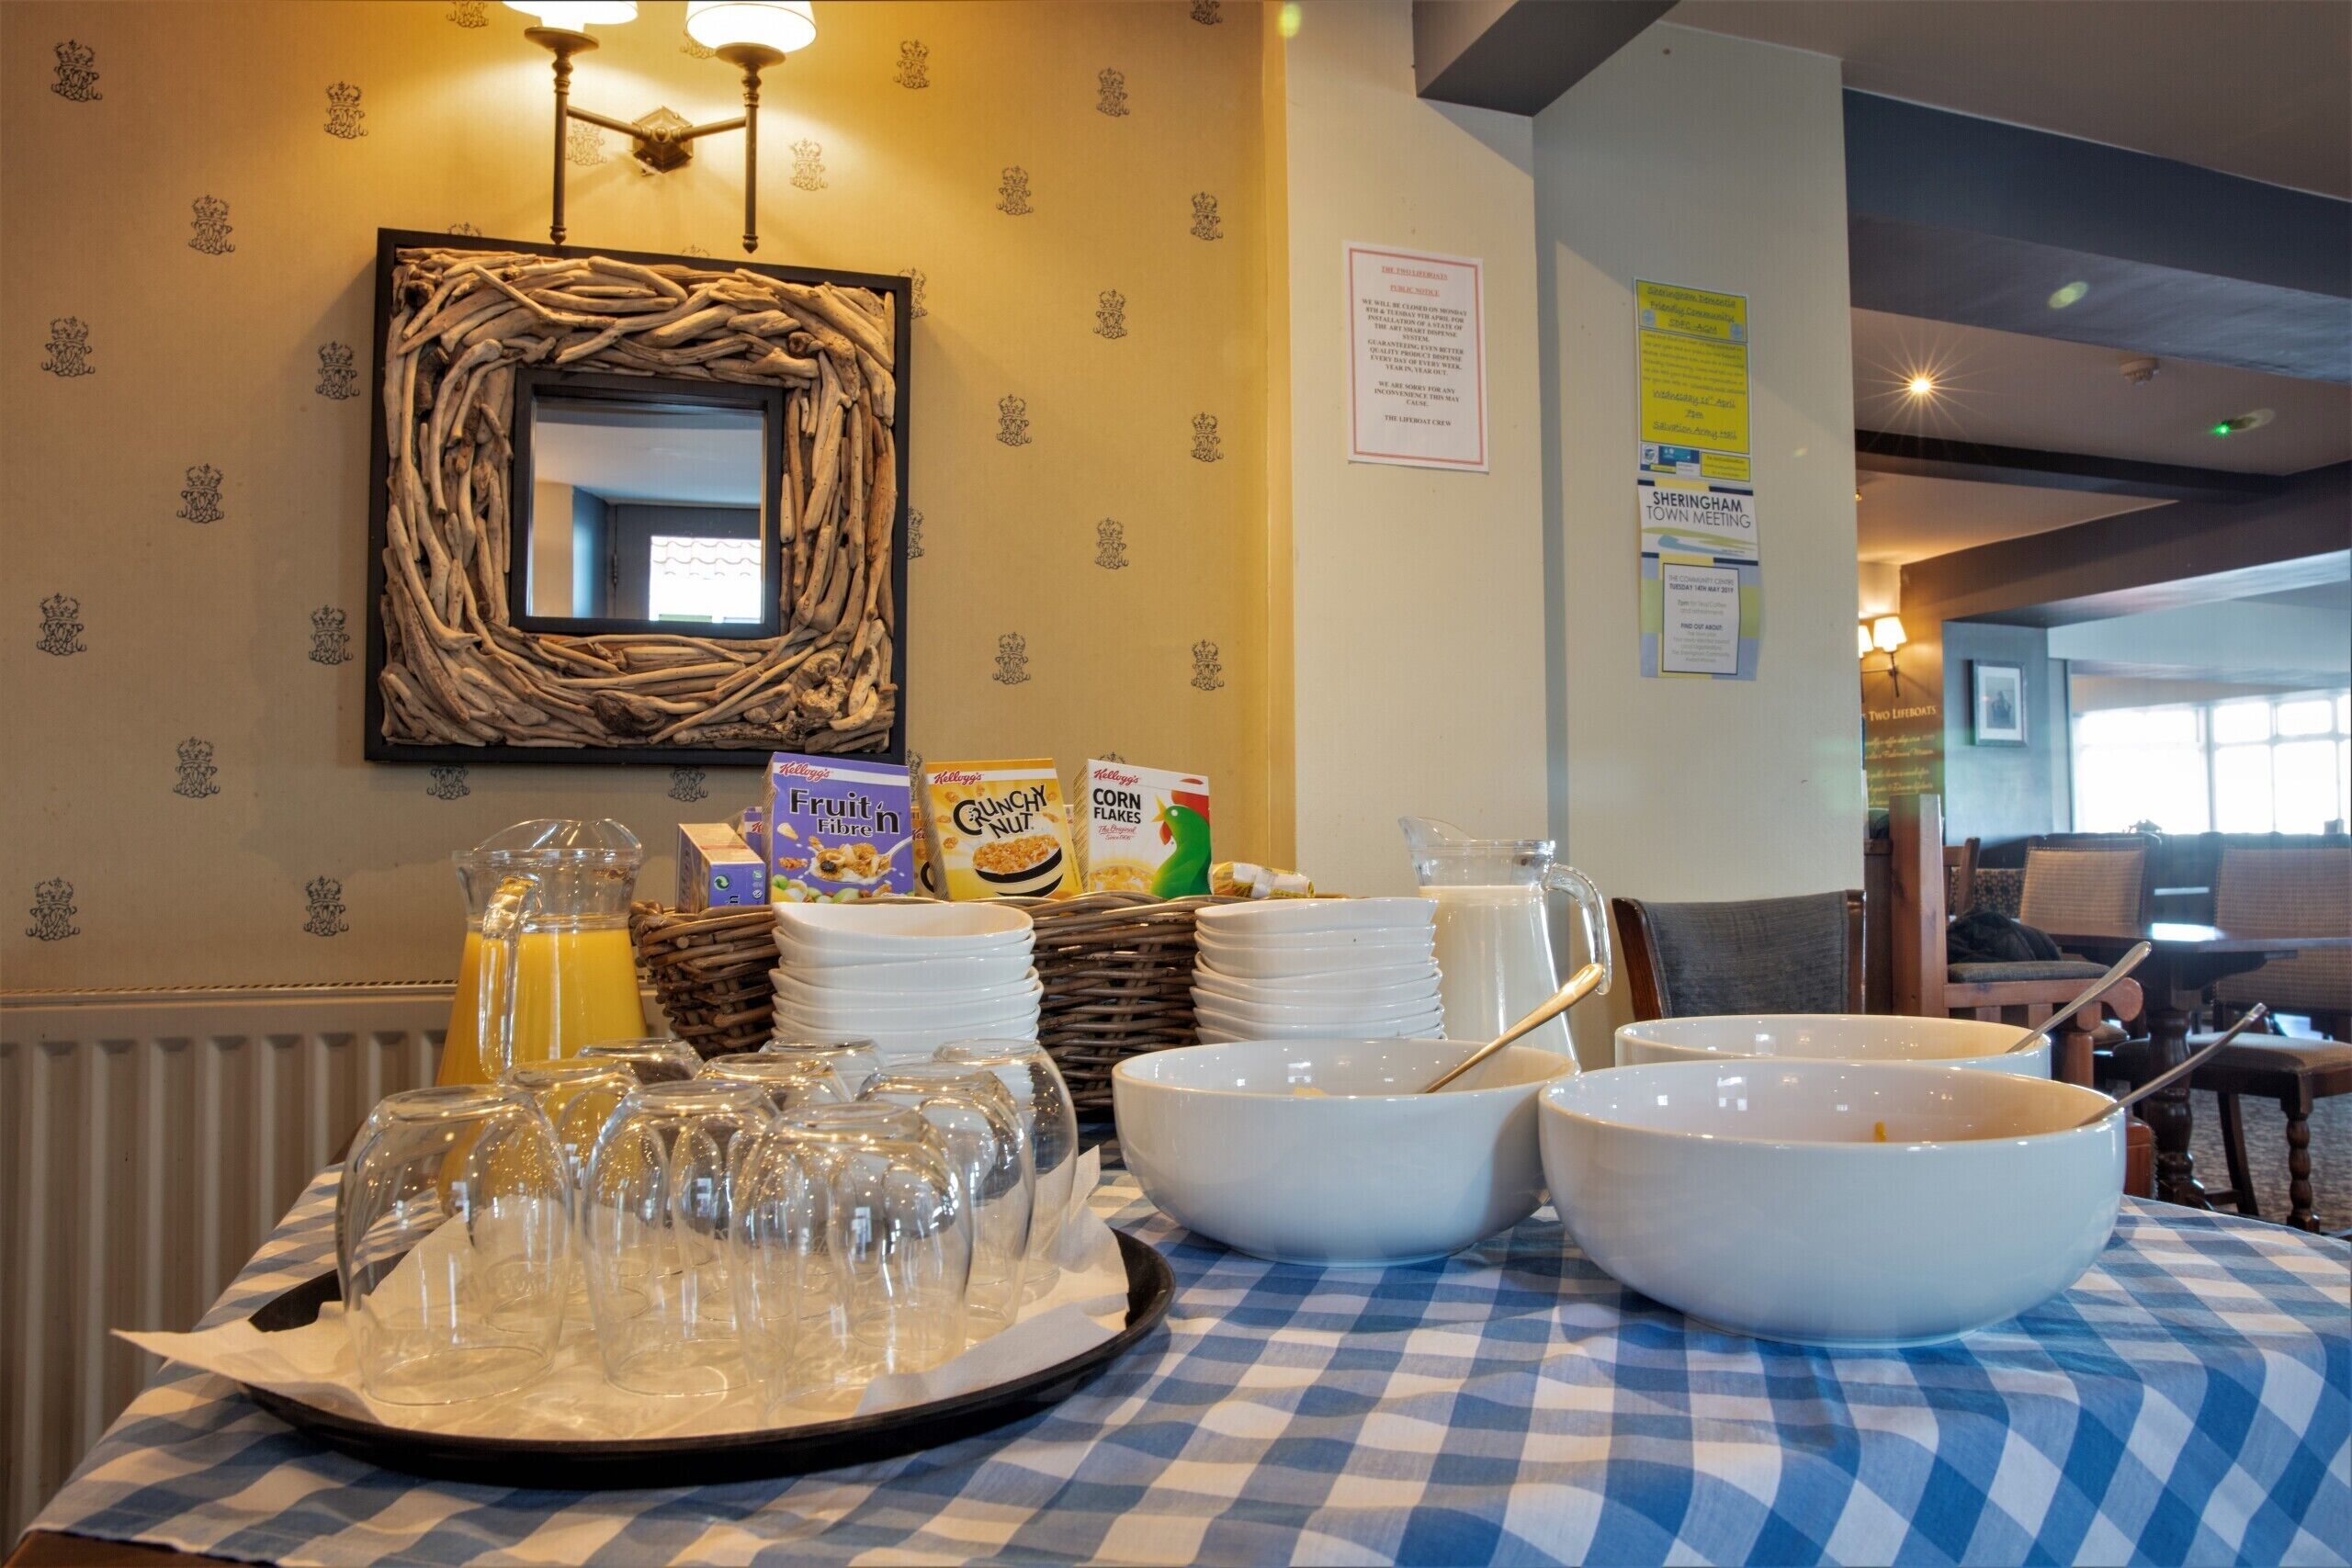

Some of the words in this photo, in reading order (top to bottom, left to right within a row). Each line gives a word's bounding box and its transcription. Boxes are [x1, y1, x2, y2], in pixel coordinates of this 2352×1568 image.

[1390, 285, 1411, 294] PUBLIC
[1416, 288, 1440, 297] NOTICE
[1387, 310, 1415, 318] TUESDAY
[1402, 304, 1427, 312] CLOSED
[1440, 308, 1467, 316] MONDAY
[1368, 314, 1415, 325] INSTALLATION
[1370, 347, 1398, 355] QUALITY
[1401, 351, 1430, 359] PRODUCT
[1440, 346, 1464, 355] BETTER
[1374, 389, 1428, 399] INCONVENIENCE
[1399, 416, 1430, 425] LIFEBOAT
[1653, 491, 1743, 513] SHERINGHAM
[1646, 506, 1689, 522] TOWN
[1693, 512, 1751, 528] MEETING
[779, 761, 831, 781] Kellogg's
[934, 771, 982, 784] Kellogg's
[1094, 769, 1138, 785] Kellogg's
[789, 787, 872, 819] Fruit
[1093, 788, 1141, 810] CORN
[953, 785, 1047, 836] CRUNCHY
[1094, 807, 1141, 824] FLAKES
[817, 818, 873, 837] Fibre
[989, 812, 1034, 839] NUT
